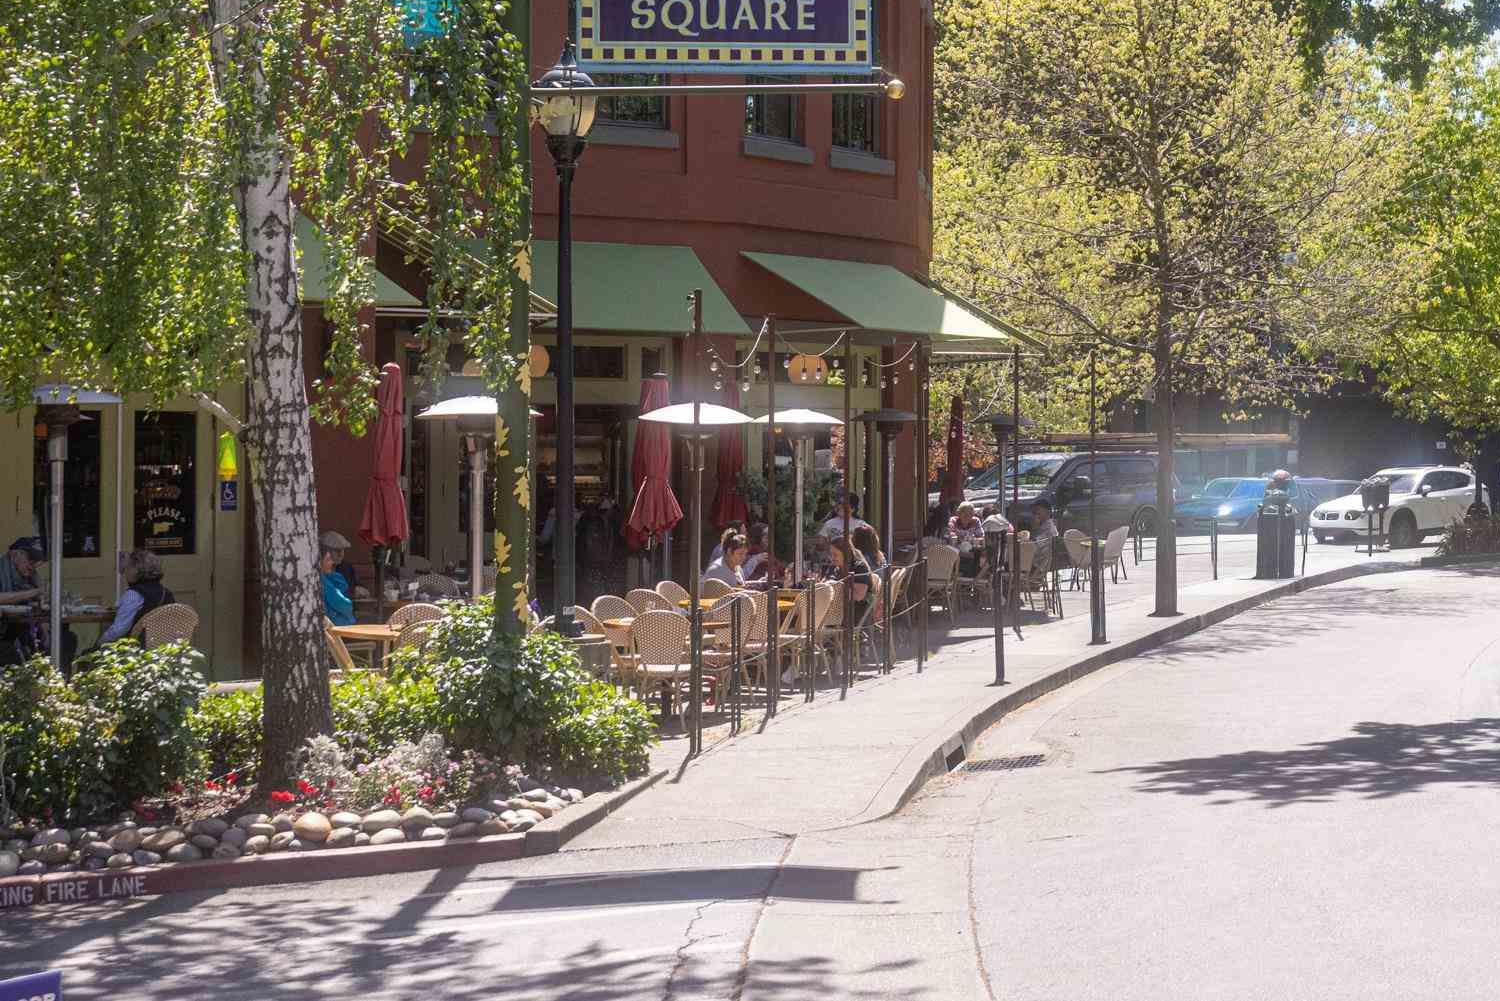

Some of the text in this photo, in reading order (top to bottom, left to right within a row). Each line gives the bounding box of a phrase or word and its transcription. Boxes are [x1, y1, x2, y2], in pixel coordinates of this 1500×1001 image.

[147, 506, 181, 520] PLEASE
[0, 876, 147, 907] ING FIRE LANE
